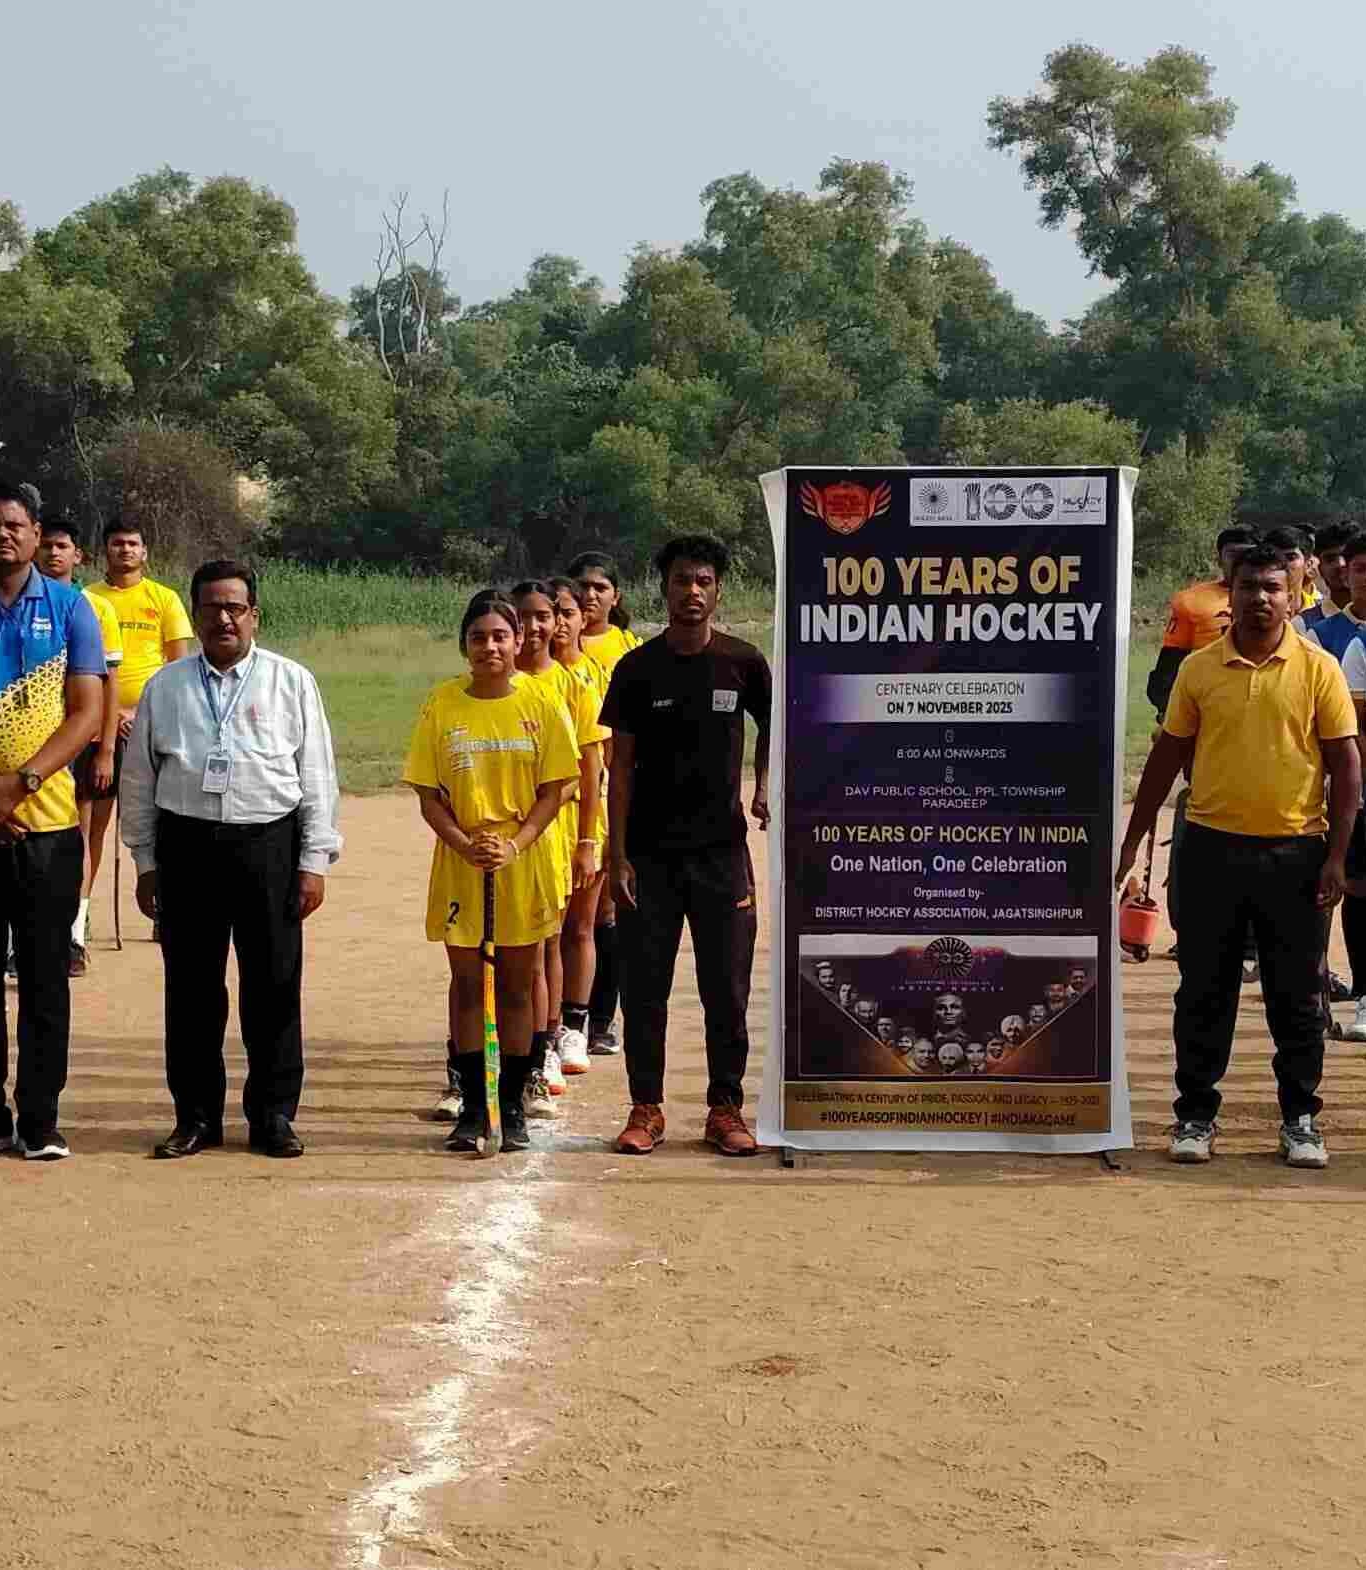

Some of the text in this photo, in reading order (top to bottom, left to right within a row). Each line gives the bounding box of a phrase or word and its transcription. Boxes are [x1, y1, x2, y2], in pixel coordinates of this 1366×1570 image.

[823, 555, 1082, 596] 100 YEARS OF
[800, 602, 1102, 642] INDIAN HOCKEY
[875, 682, 1025, 696] CENTENARY CELEBRATION
[887, 702, 1013, 714] ON 7 NOVEMBER 2025
[922, 748, 942, 759] AM
[944, 748, 1007, 759] ONWARDS
[844, 786, 869, 796] DAV
[873, 786, 916, 796] PUBLIC
[1001, 786, 1066, 797] TOWNSHIP
[922, 799, 988, 809] PARADEEP
[813, 825, 1088, 843] 100 YEARS OF HOCKEY IN INDIA
[830, 855, 1067, 876] One Nation, One Celebration
[815, 906, 863, 918] DISTRICT
[866, 906, 910, 918] HOCKEY
[992, 907, 1083, 919] JAGATSINGHPUR
